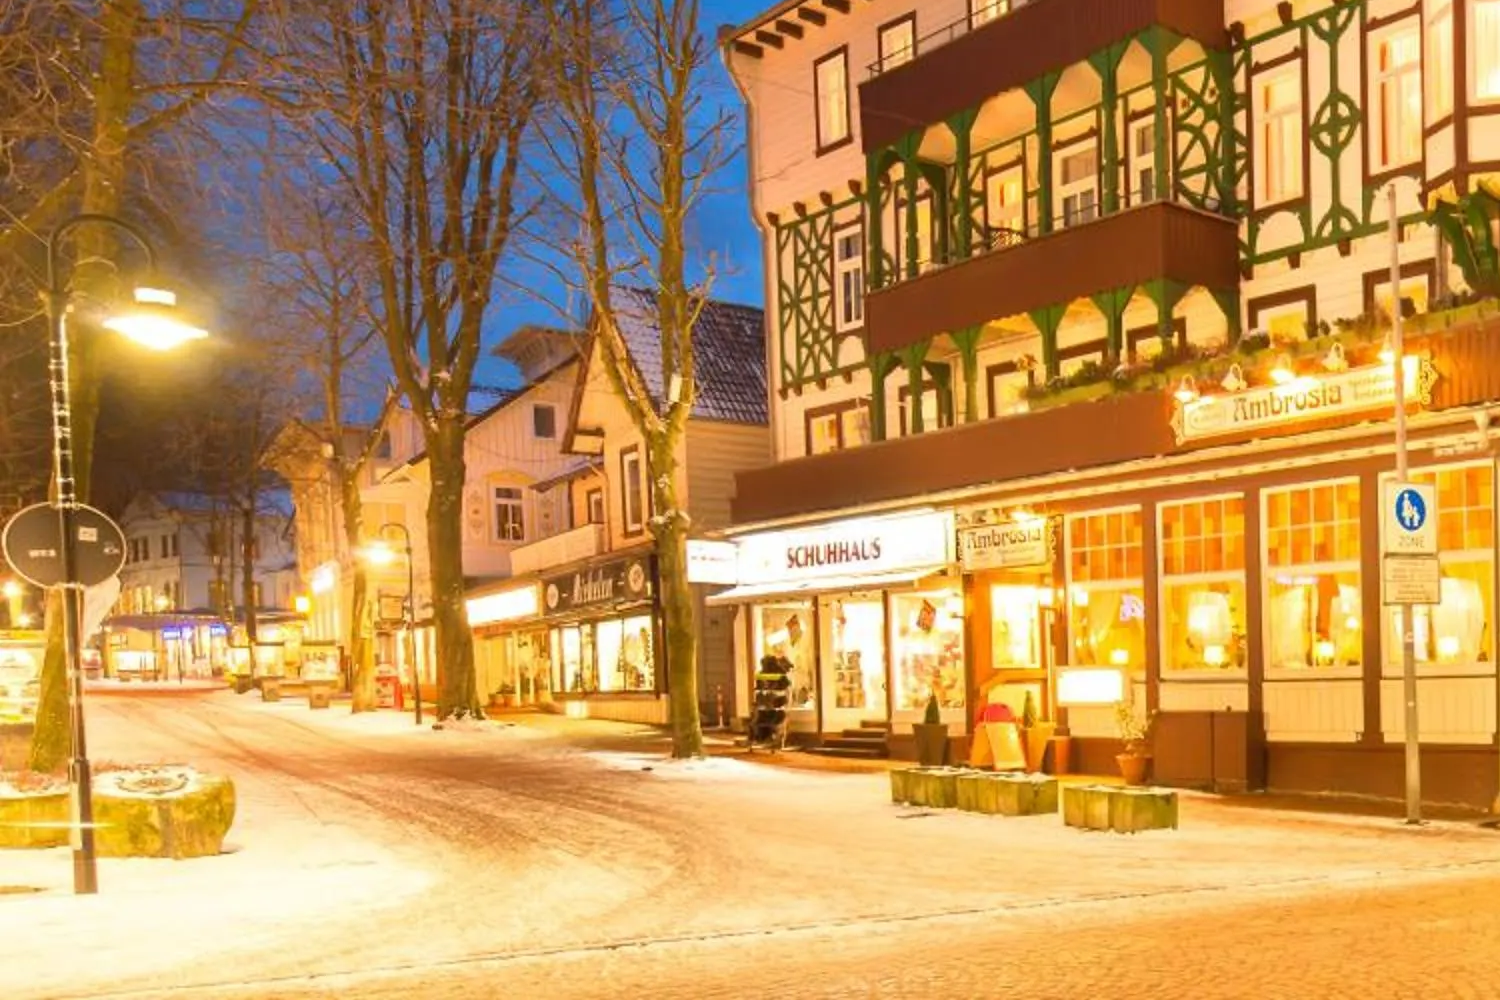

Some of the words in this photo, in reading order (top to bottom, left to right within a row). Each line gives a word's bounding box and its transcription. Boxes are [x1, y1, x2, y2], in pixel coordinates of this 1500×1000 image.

[1233, 382, 1342, 422] Ambrosia
[966, 527, 1041, 549] Ambrosia
[1399, 535, 1425, 549] ZONE
[787, 537, 881, 568] SCHUHHAUS
